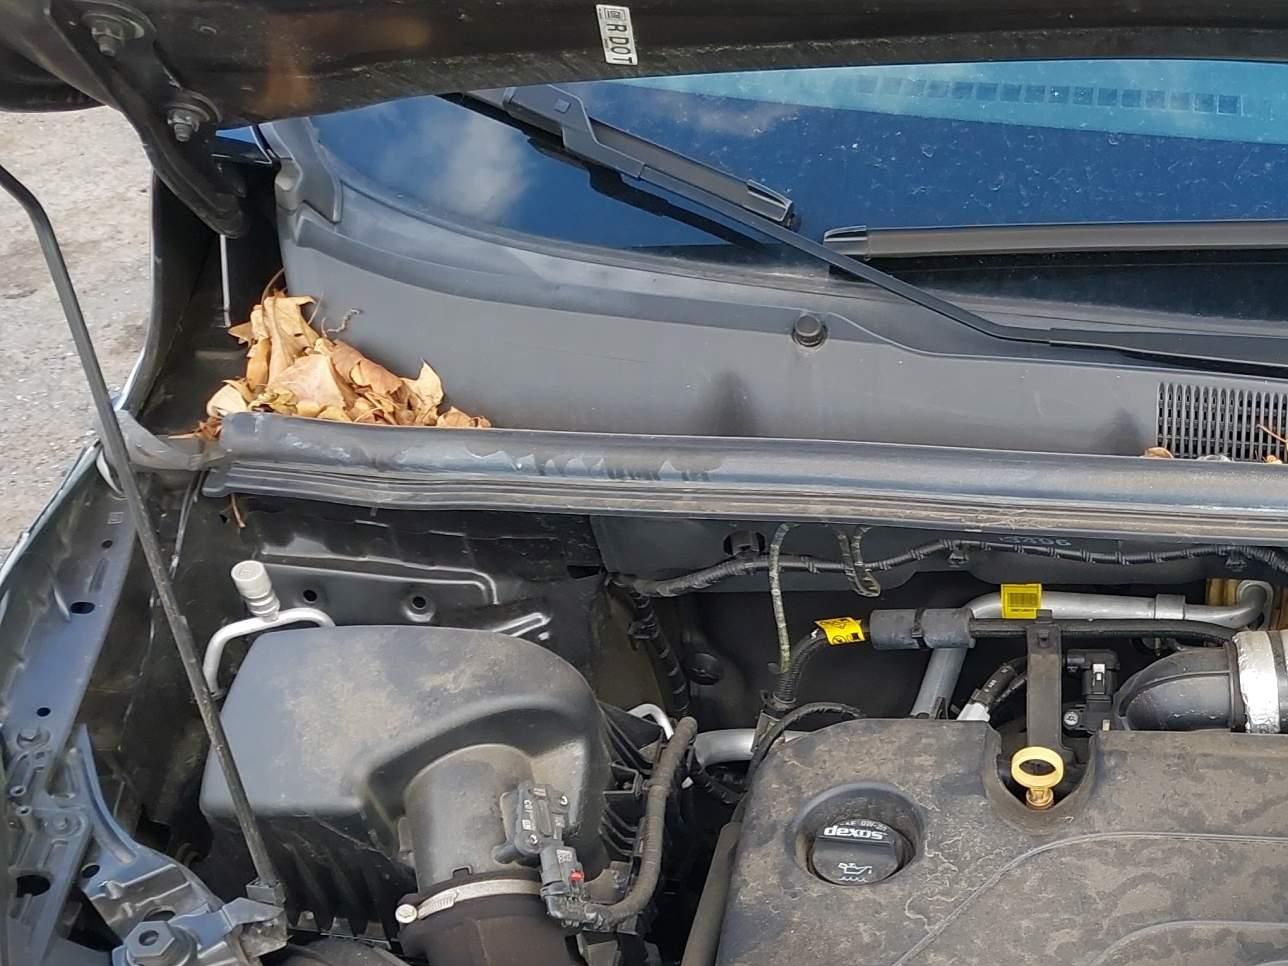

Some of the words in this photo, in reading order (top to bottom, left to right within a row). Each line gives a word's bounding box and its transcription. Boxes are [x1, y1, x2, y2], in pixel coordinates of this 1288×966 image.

[606, 23, 627, 32] R
[608, 36, 633, 64] DOT
[823, 825, 888, 840] dexos
